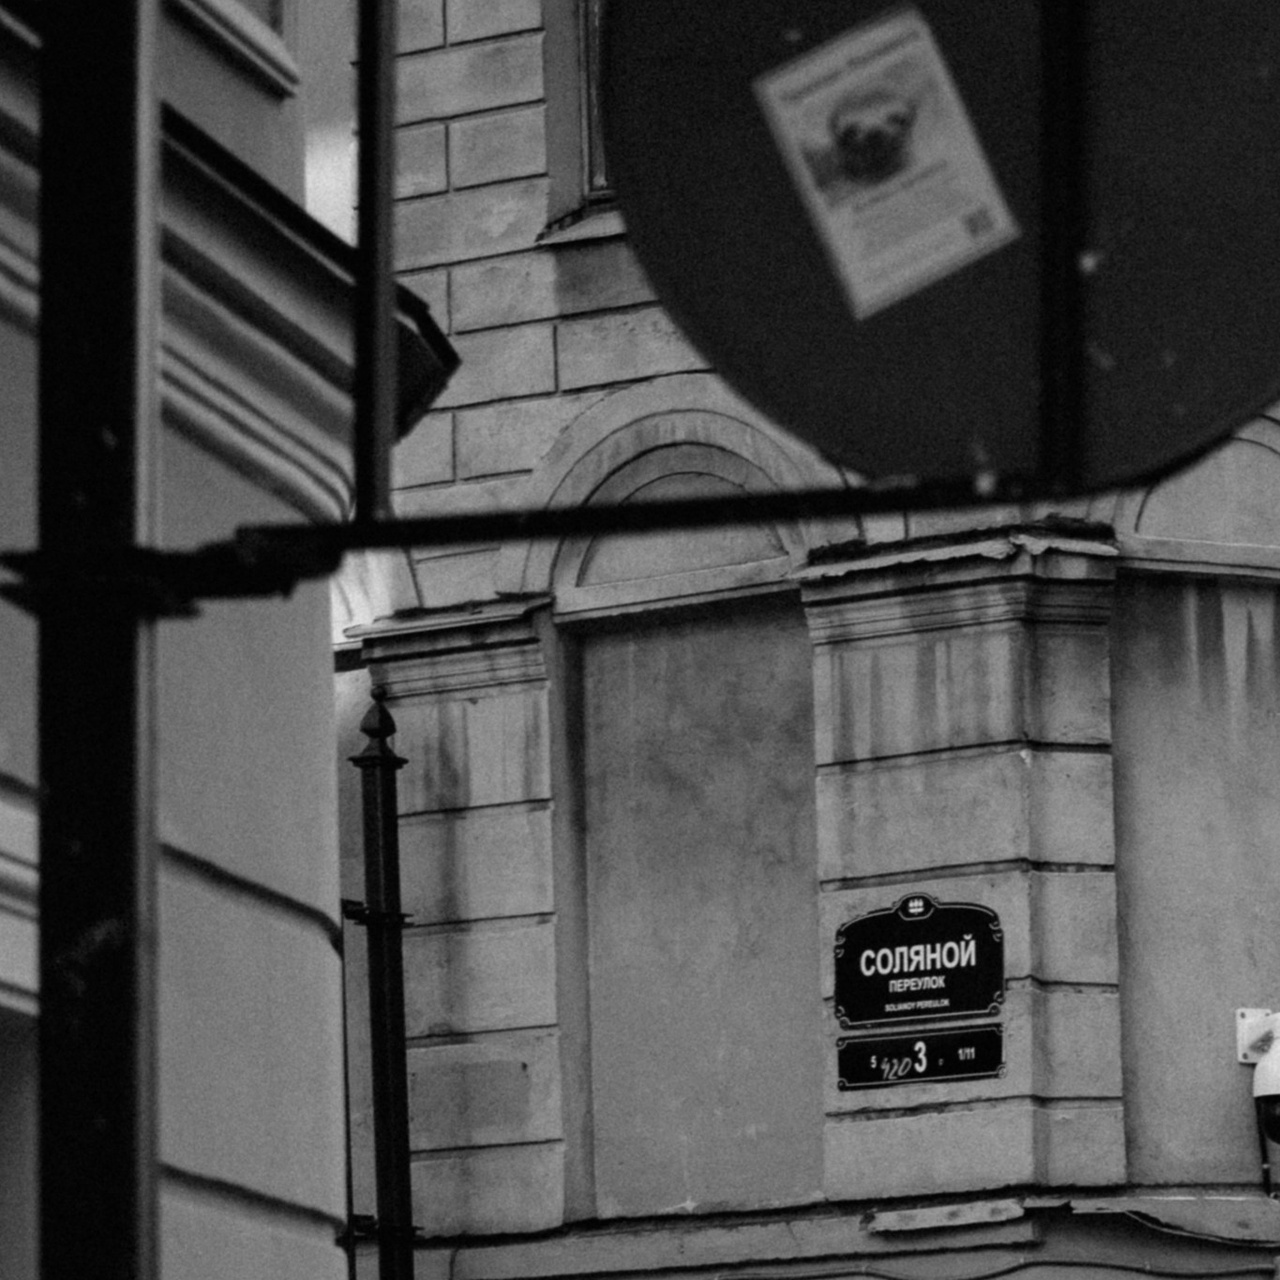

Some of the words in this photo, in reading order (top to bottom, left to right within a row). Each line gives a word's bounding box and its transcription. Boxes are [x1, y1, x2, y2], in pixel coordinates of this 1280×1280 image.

[860, 933, 976, 976] СОЛЯНОЙ
[888, 975, 946, 993] ПЕРЕУЛОК
[870, 1055, 877, 1069] 5
[913, 1041, 927, 1073] 3
